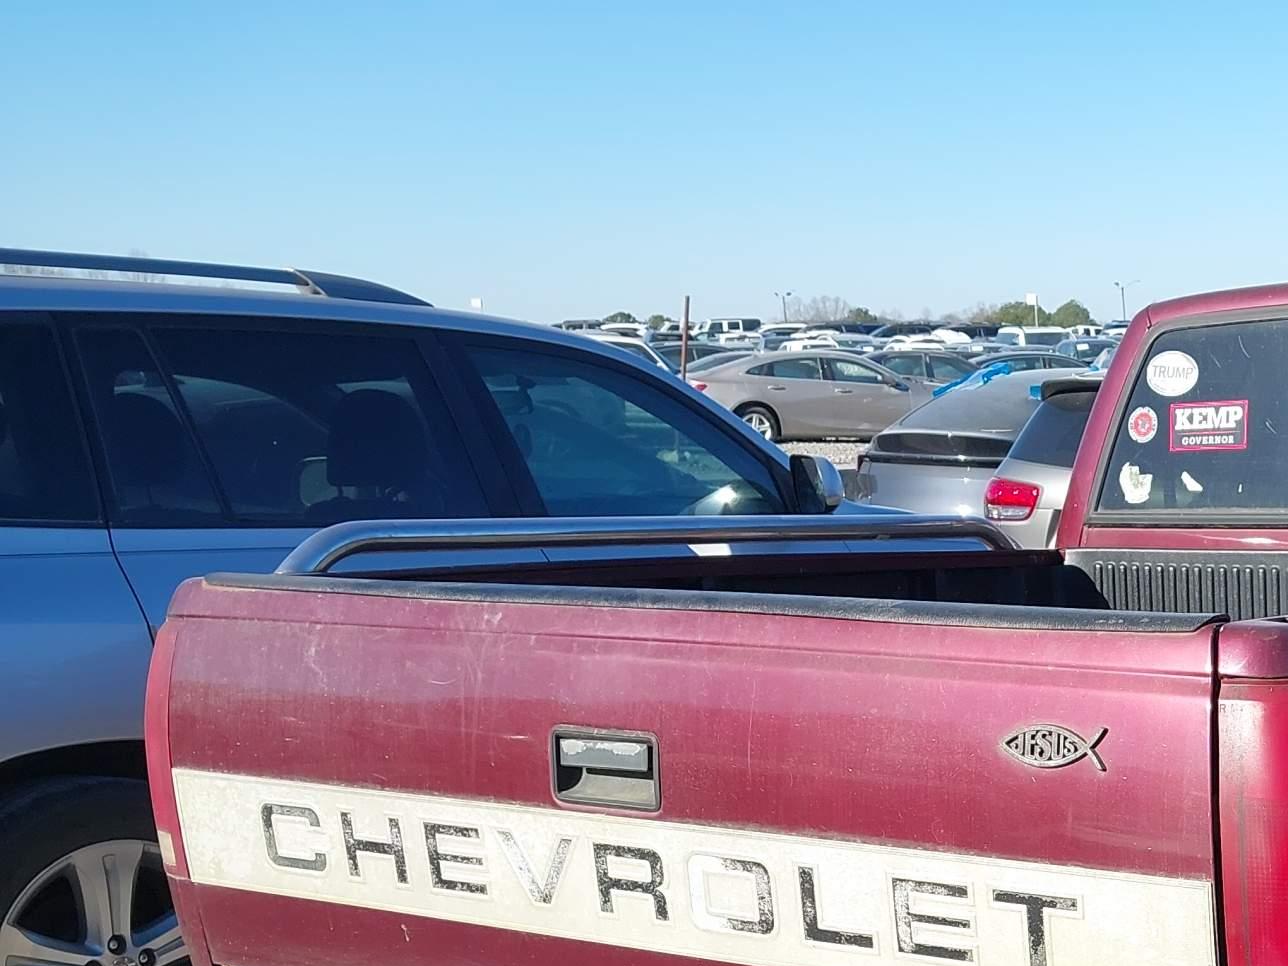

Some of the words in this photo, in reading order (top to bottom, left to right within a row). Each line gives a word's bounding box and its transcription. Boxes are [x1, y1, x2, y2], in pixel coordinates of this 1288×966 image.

[1152, 364, 1194, 380] TRUMP
[1174, 406, 1243, 431] KEMP
[1181, 435, 1234, 446] GOVERNOR
[1010, 730, 1078, 761] JESUS
